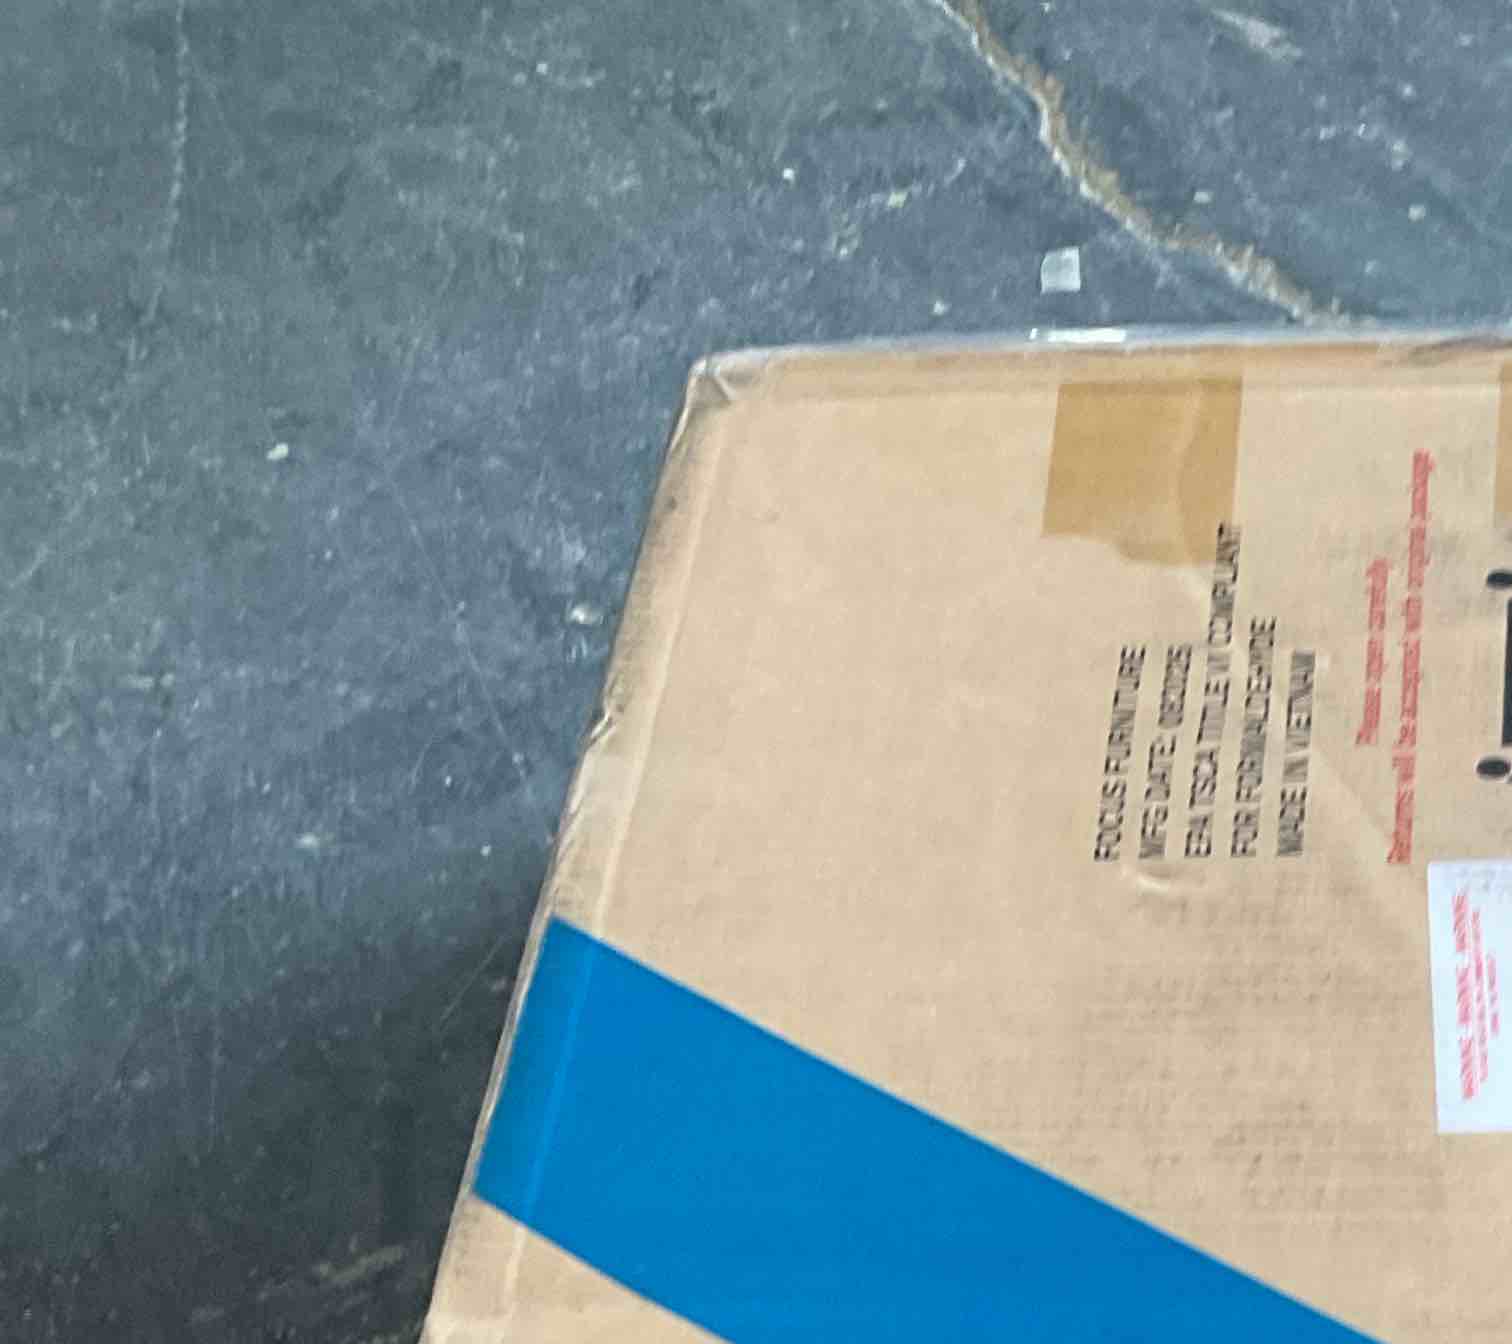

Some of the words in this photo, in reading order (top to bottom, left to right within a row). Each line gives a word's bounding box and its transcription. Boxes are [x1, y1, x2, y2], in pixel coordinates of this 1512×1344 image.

[1105, 646, 1145, 777] FURNITURE
[1196, 679, 1229, 743] TITLE
[1286, 649, 1315, 753] VIETNAM
[1146, 735, 1176, 801] DATE:
[1189, 746, 1219, 808] TSCA
[1093, 781, 1127, 862] FOCUS
[1185, 815, 1212, 858] EPA
[1231, 811, 1259, 858] FOR
[1276, 786, 1308, 858] MADE
